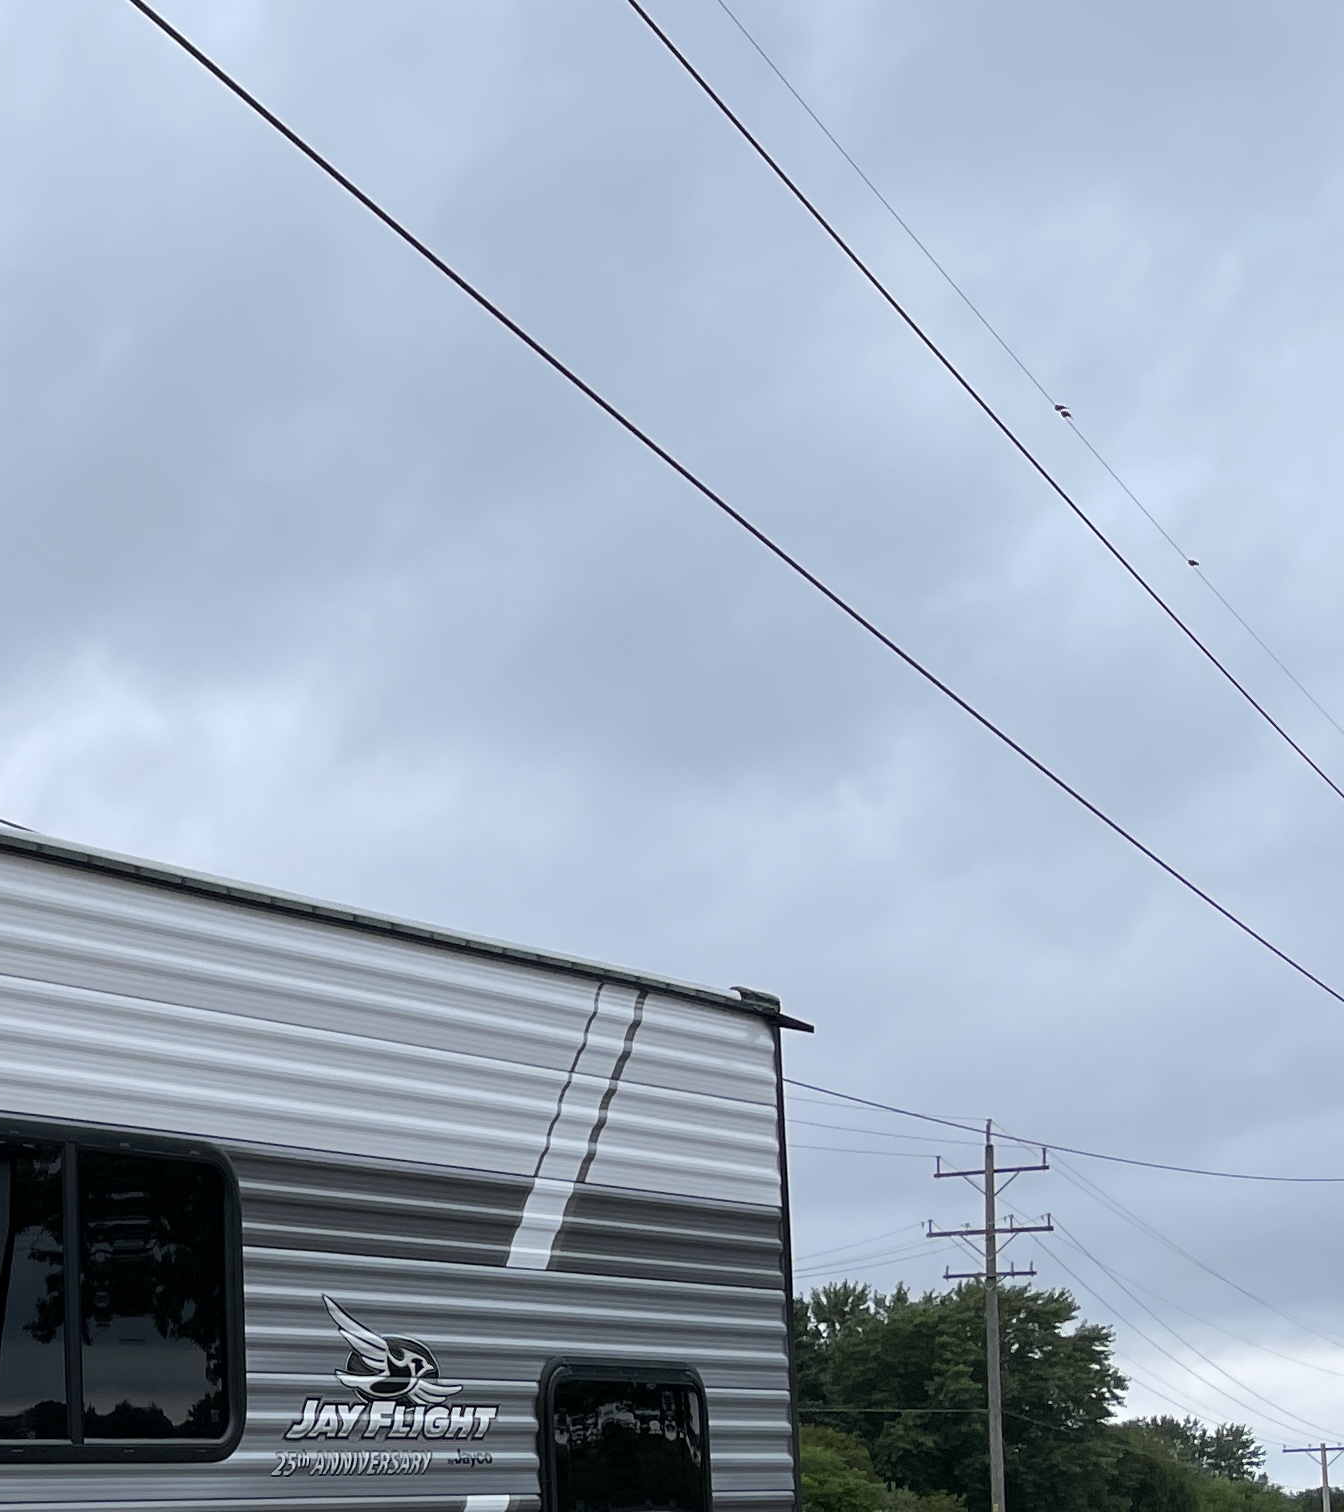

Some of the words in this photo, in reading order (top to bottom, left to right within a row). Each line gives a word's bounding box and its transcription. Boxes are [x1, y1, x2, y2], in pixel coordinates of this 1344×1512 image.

[283, 1396, 365, 1441] JAY
[361, 1398, 499, 1441] FLIGHT
[271, 1448, 311, 1477] 25th
[310, 1449, 432, 1477] ANNIVERSARY
[454, 1448, 493, 1468] Jayco
